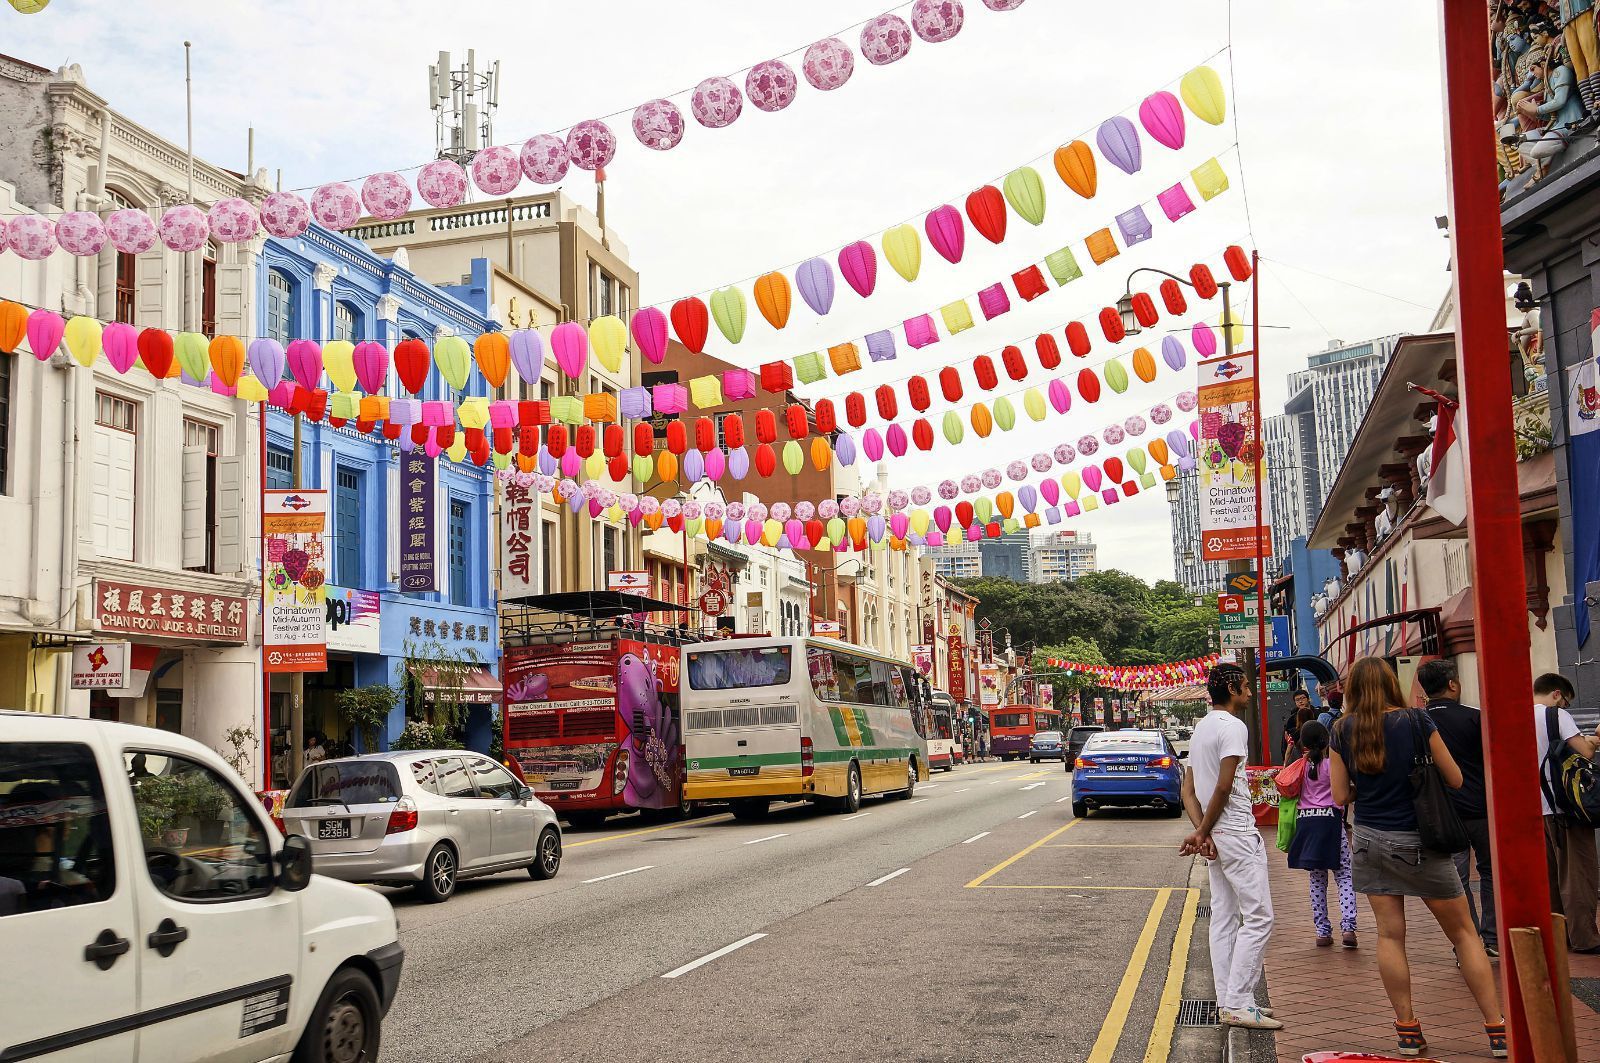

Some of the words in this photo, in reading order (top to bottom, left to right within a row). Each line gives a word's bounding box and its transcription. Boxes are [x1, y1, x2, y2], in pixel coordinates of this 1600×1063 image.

[1209, 486, 1257, 497] Chinatow
[1209, 496, 1257, 506] Mid-Autum
[1210, 506, 1240, 516] Festival
[1242, 504, 1257, 513] 201
[505, 462, 534, 585] 鞋帽公司
[1223, 516, 1237, 525] Aug
[419, 562, 433, 570] SOCIETY
[410, 577, 426, 586] 249
[272, 606, 321, 616] Chinatown
[1224, 613, 1241, 622] Taxi
[101, 613, 130, 628] CHAN
[132, 616, 160, 630] FOON
[161, 620, 185, 633] JADE
[187, 622, 194, 633] &
[195, 623, 242, 637] JEWELLERY
[272, 623, 301, 632] Festival
[302, 623, 321, 631] 2013
[283, 633, 297, 641] Aug
[1222, 633, 1232, 645] 4
[573, 644, 597, 652] Singapore
[325, 820, 343, 829] SGW
[320, 827, 349, 838] 3238H
